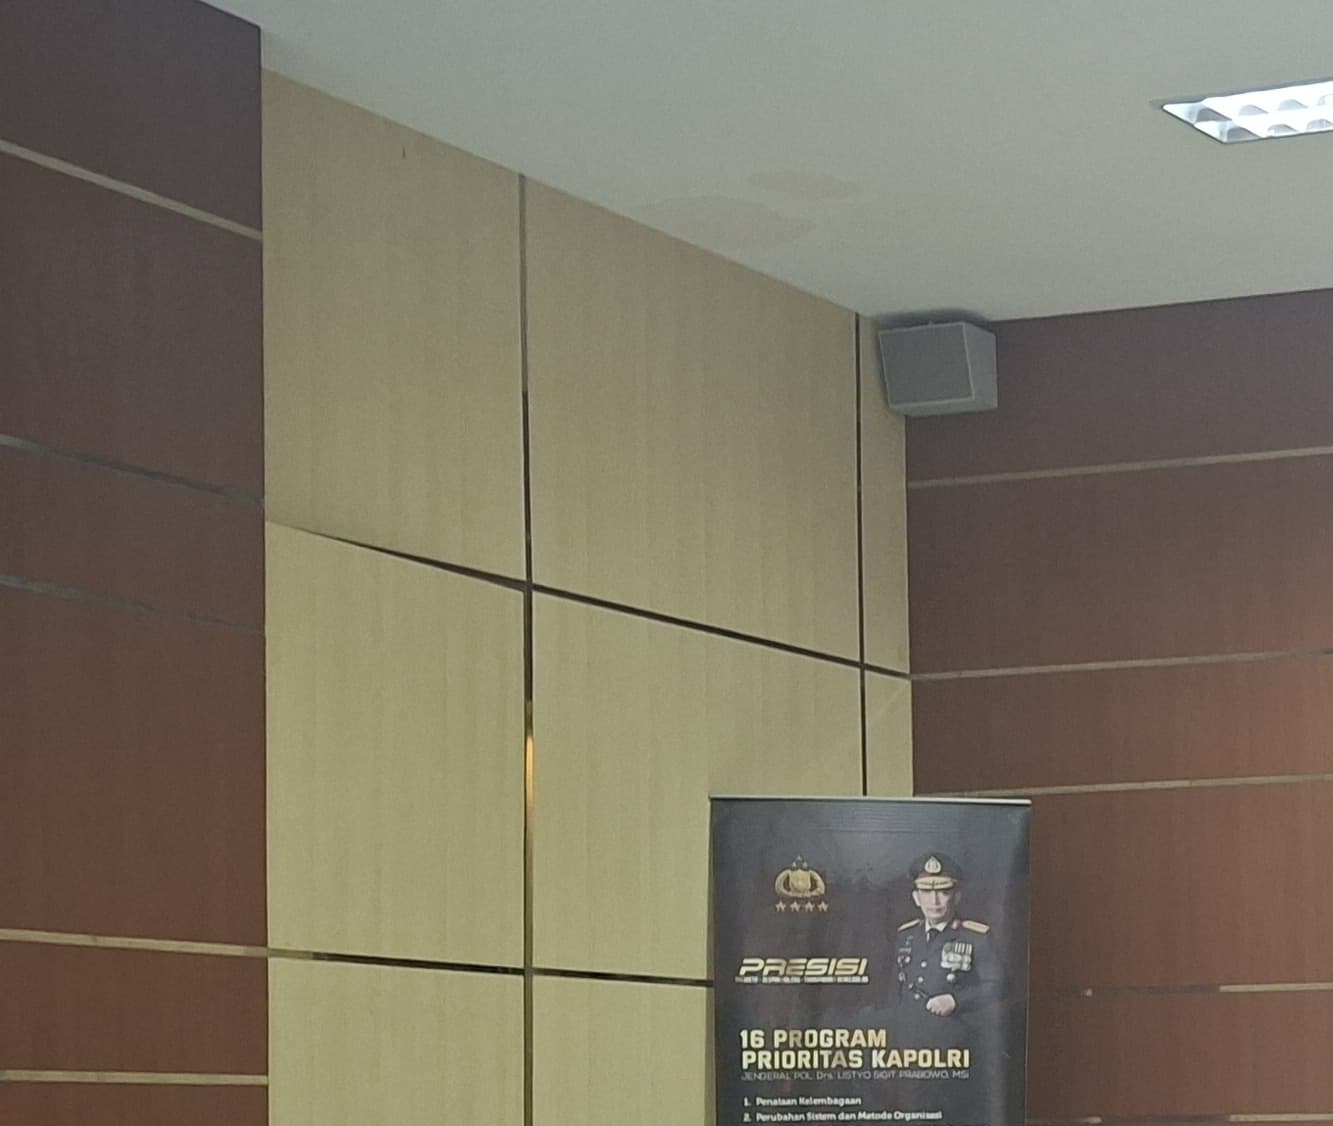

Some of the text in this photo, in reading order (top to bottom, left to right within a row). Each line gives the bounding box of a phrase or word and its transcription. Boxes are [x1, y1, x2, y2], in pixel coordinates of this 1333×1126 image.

[739, 958, 868, 976] PRESISI
[740, 1028, 886, 1048] 16 PROGRAM
[742, 1049, 969, 1069] PRIORITAS KAPOLRI
